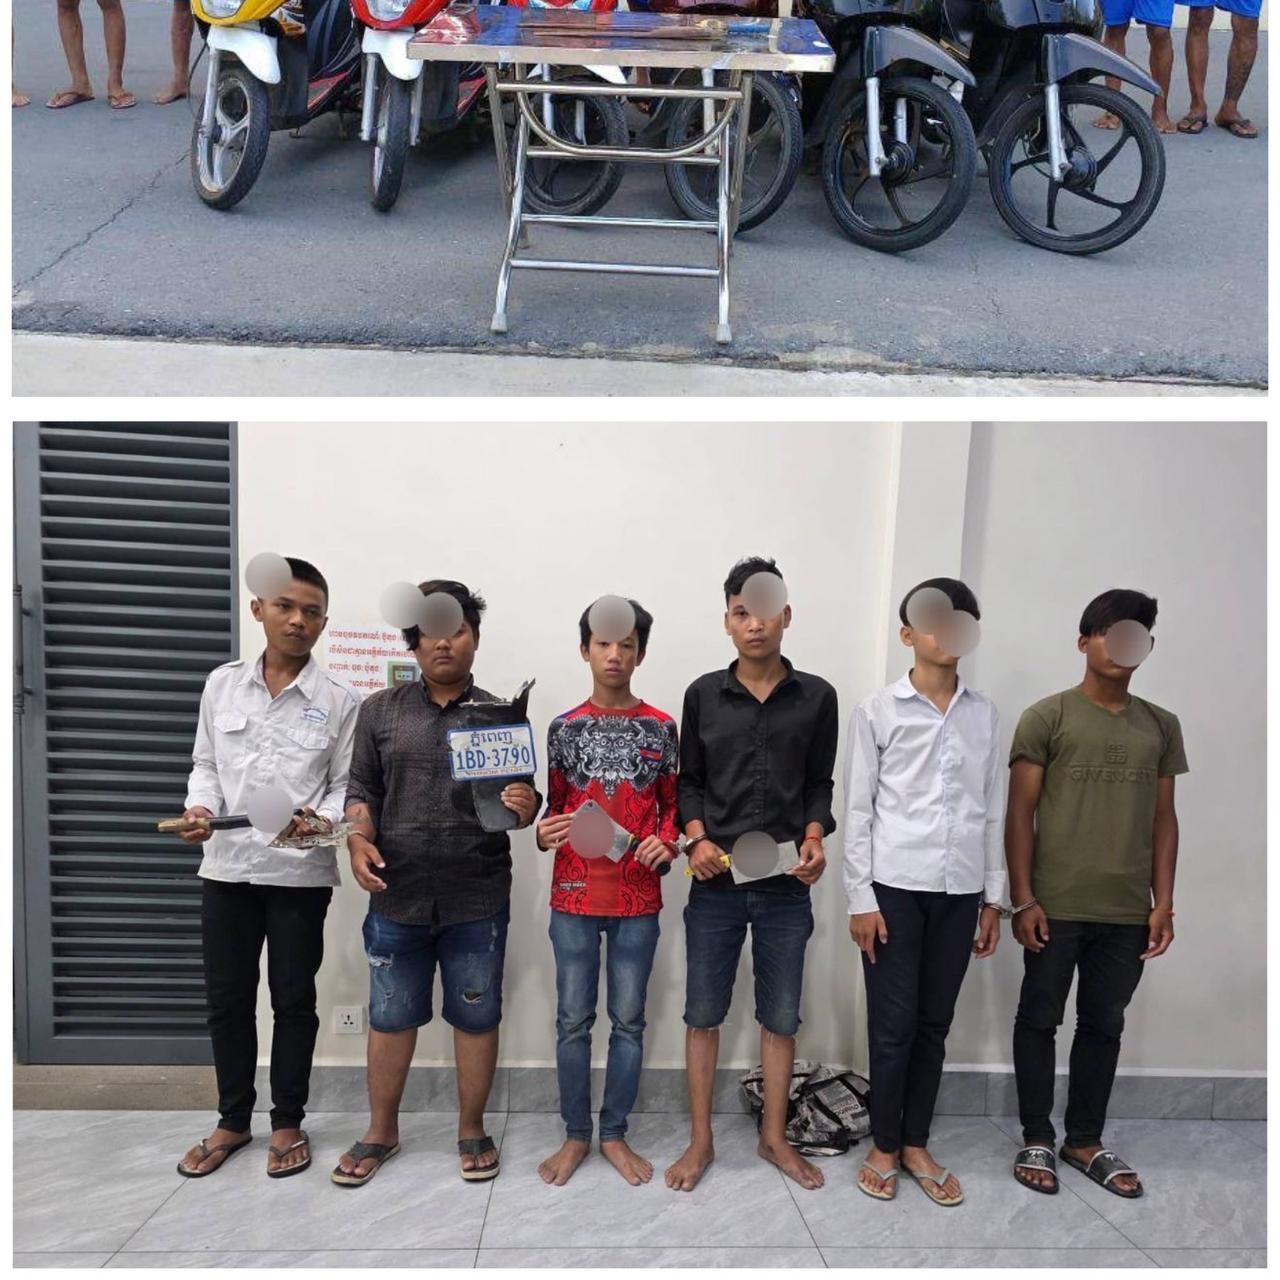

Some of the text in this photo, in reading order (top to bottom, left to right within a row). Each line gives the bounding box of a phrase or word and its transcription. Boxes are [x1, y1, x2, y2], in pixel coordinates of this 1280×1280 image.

[470, 730, 513, 747] ភ្នំពេញ
[456, 746, 530, 771] 1BD-3790
